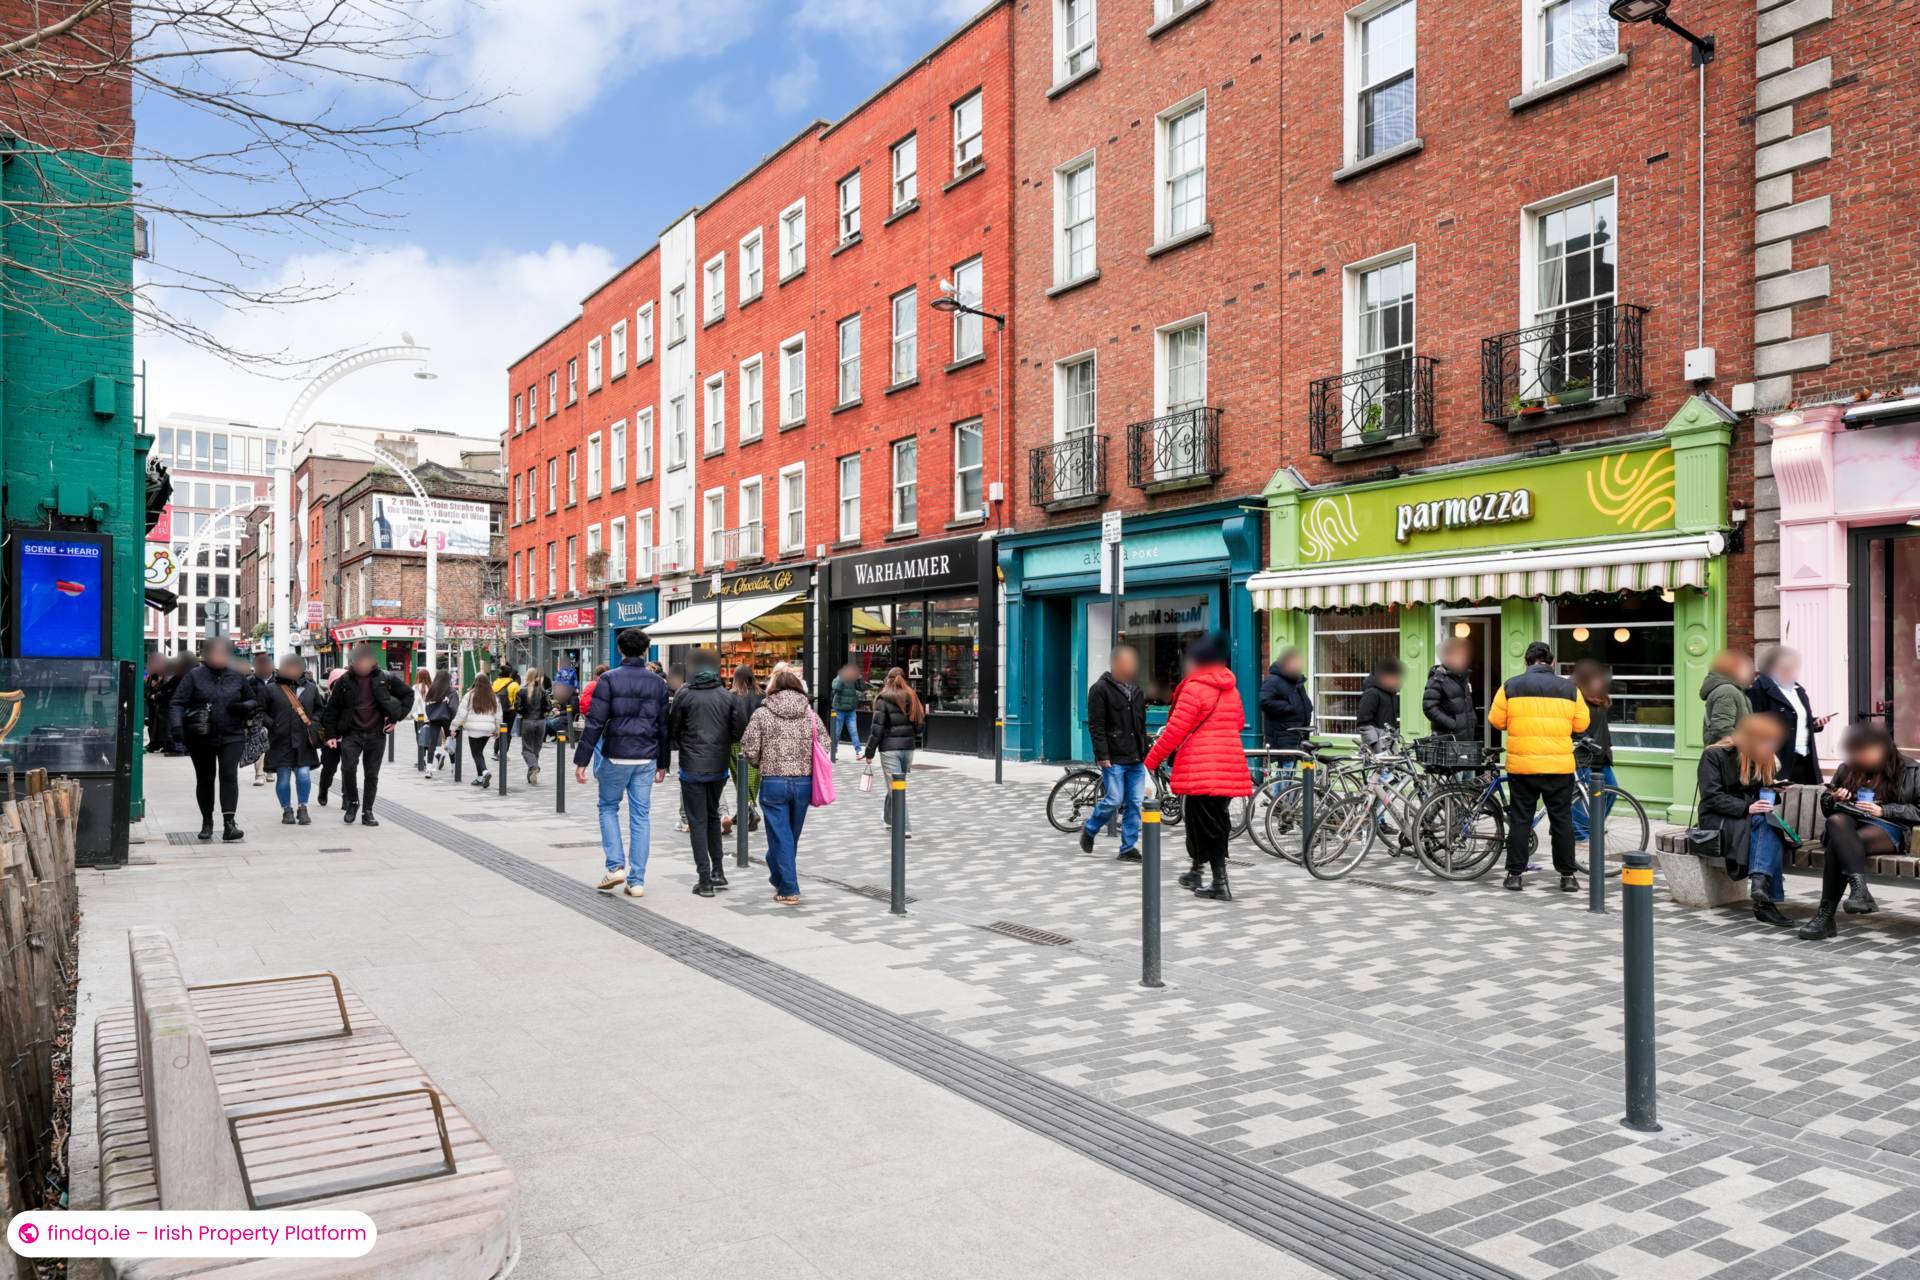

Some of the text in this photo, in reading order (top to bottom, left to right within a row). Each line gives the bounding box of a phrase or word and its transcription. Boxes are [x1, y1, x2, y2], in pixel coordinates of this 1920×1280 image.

[1397, 488, 1532, 542] parmezza
[24, 545, 57, 554] SCENE
[67, 547, 99, 556] HEARD
[1132, 547, 1159, 560] POKÉ
[855, 555, 950, 585] WARHAMMER
[558, 613, 578, 627] SPAR
